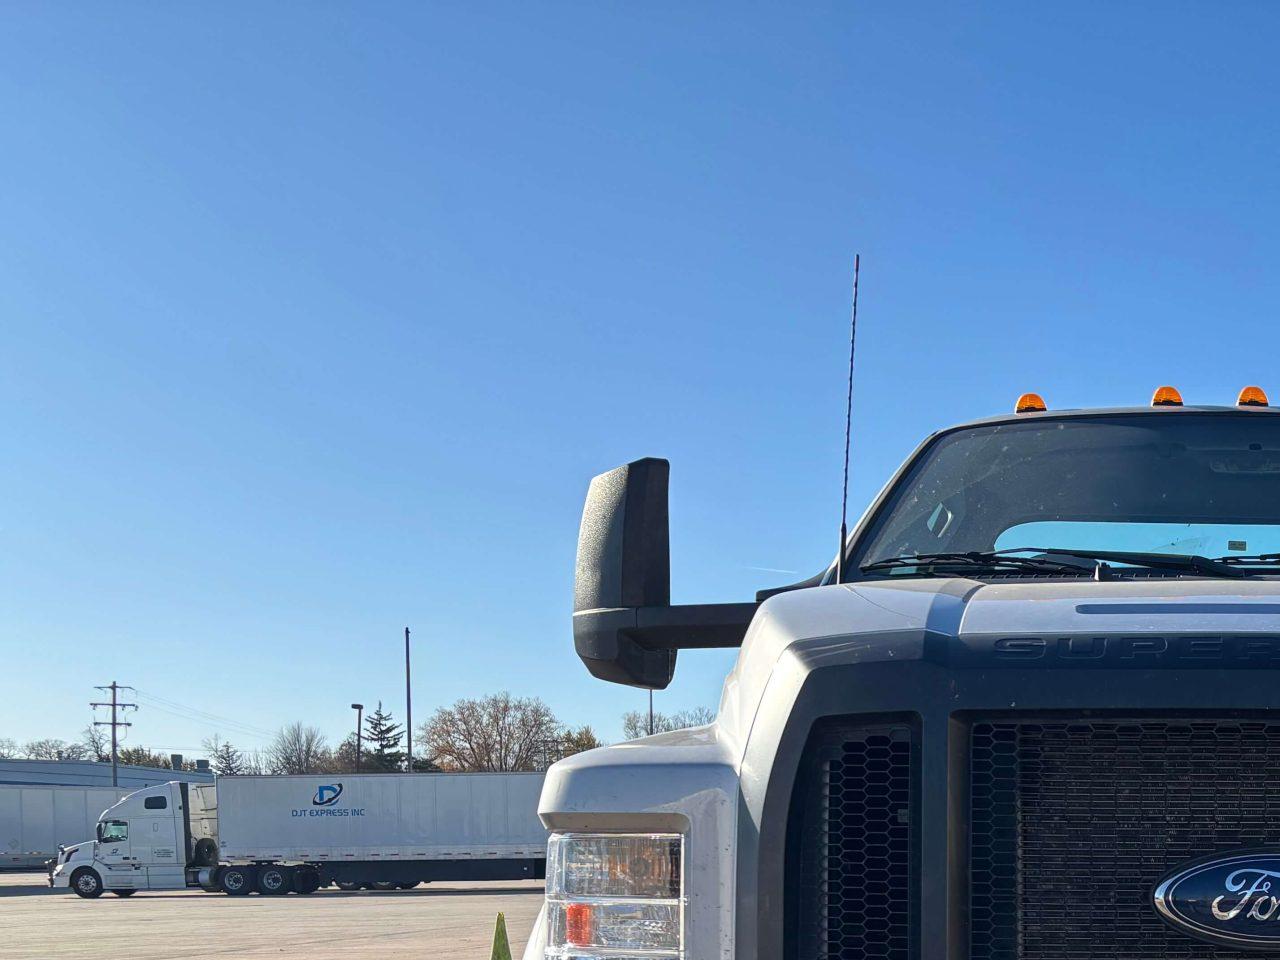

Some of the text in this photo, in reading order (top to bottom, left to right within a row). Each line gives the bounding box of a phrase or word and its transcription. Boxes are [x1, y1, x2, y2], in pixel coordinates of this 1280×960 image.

[291, 808, 366, 817] DJT EXPRESS INC
